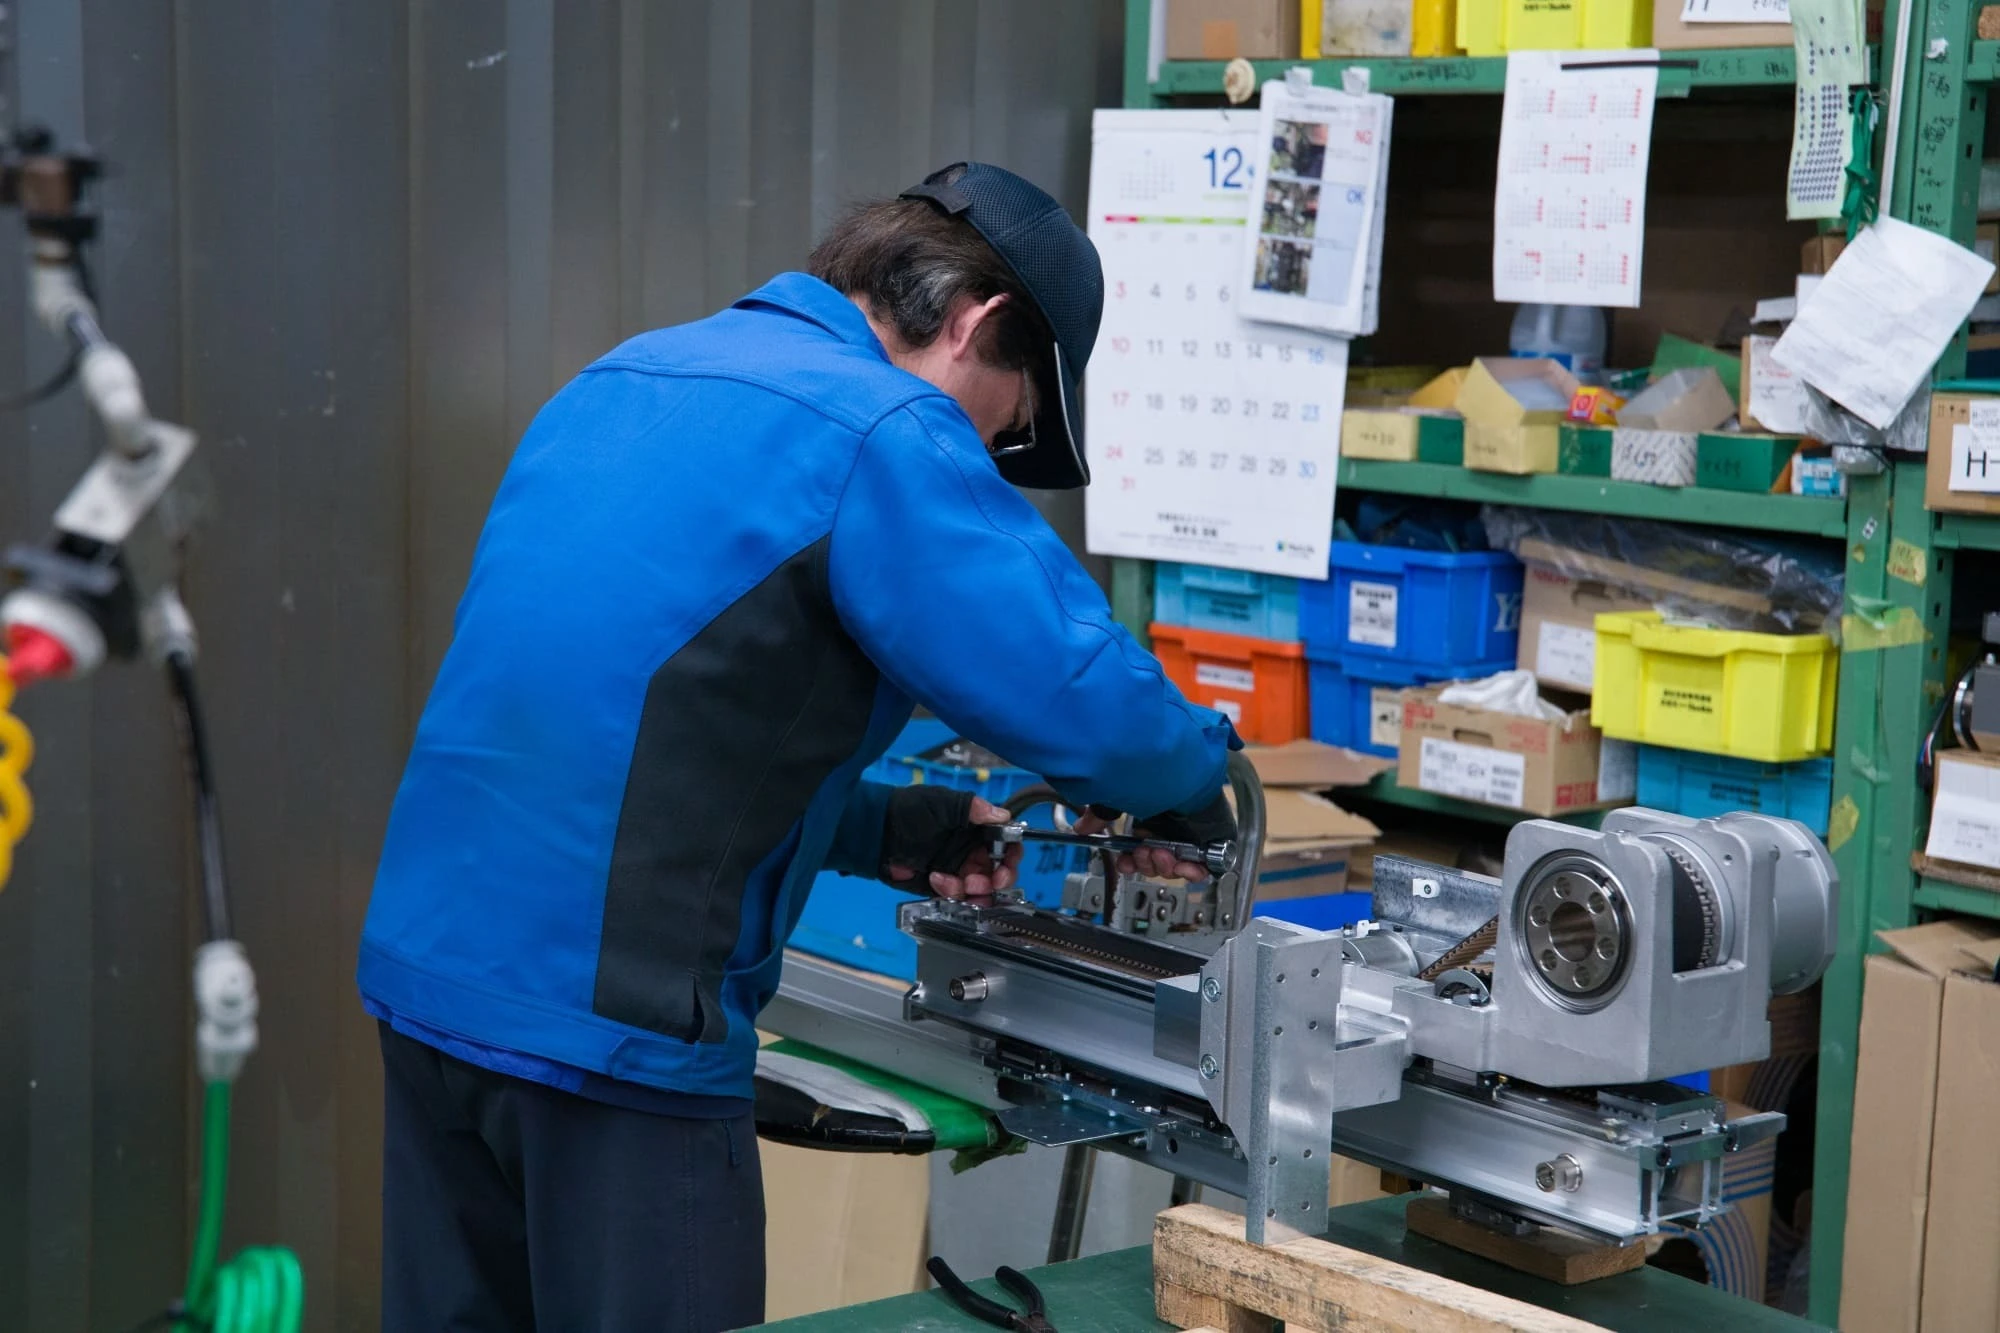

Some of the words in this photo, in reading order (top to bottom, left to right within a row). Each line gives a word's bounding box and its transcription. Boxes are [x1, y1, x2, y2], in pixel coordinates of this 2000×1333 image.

[1355, 129, 1373, 145] NG
[1203, 147, 1243, 188] 12
[1347, 188, 1364, 204] OK
[1116, 281, 1126, 299] 3
[1150, 283, 1161, 299] 4
[1186, 283, 1196, 301] 5
[1219, 285, 1230, 302] 6
[1112, 337, 1130, 353] 10
[1148, 339, 1164, 355] 11
[1182, 340, 1198, 358] 12
[1214, 341, 1232, 358] 13
[1246, 343, 1263, 360] 14
[1277, 345, 1293, 363] 15
[1307, 347, 1324, 363] 16
[1111, 391, 1129, 407] 17
[1145, 393, 1164, 411] 18
[1179, 395, 1198, 412] 19
[1211, 397, 1232, 415] 20
[1243, 399, 1259, 416] 21
[1272, 401, 1290, 419] 22
[1301, 404, 1320, 421] 23
[1105, 445, 1123, 459] 24
[1145, 447, 1164, 465] 25
[1177, 449, 1197, 468] 26
[1210, 452, 1228, 470] 27
[1239, 455, 1257, 473] 28
[1269, 457, 1287, 476] 29
[1298, 460, 1317, 479] 30
